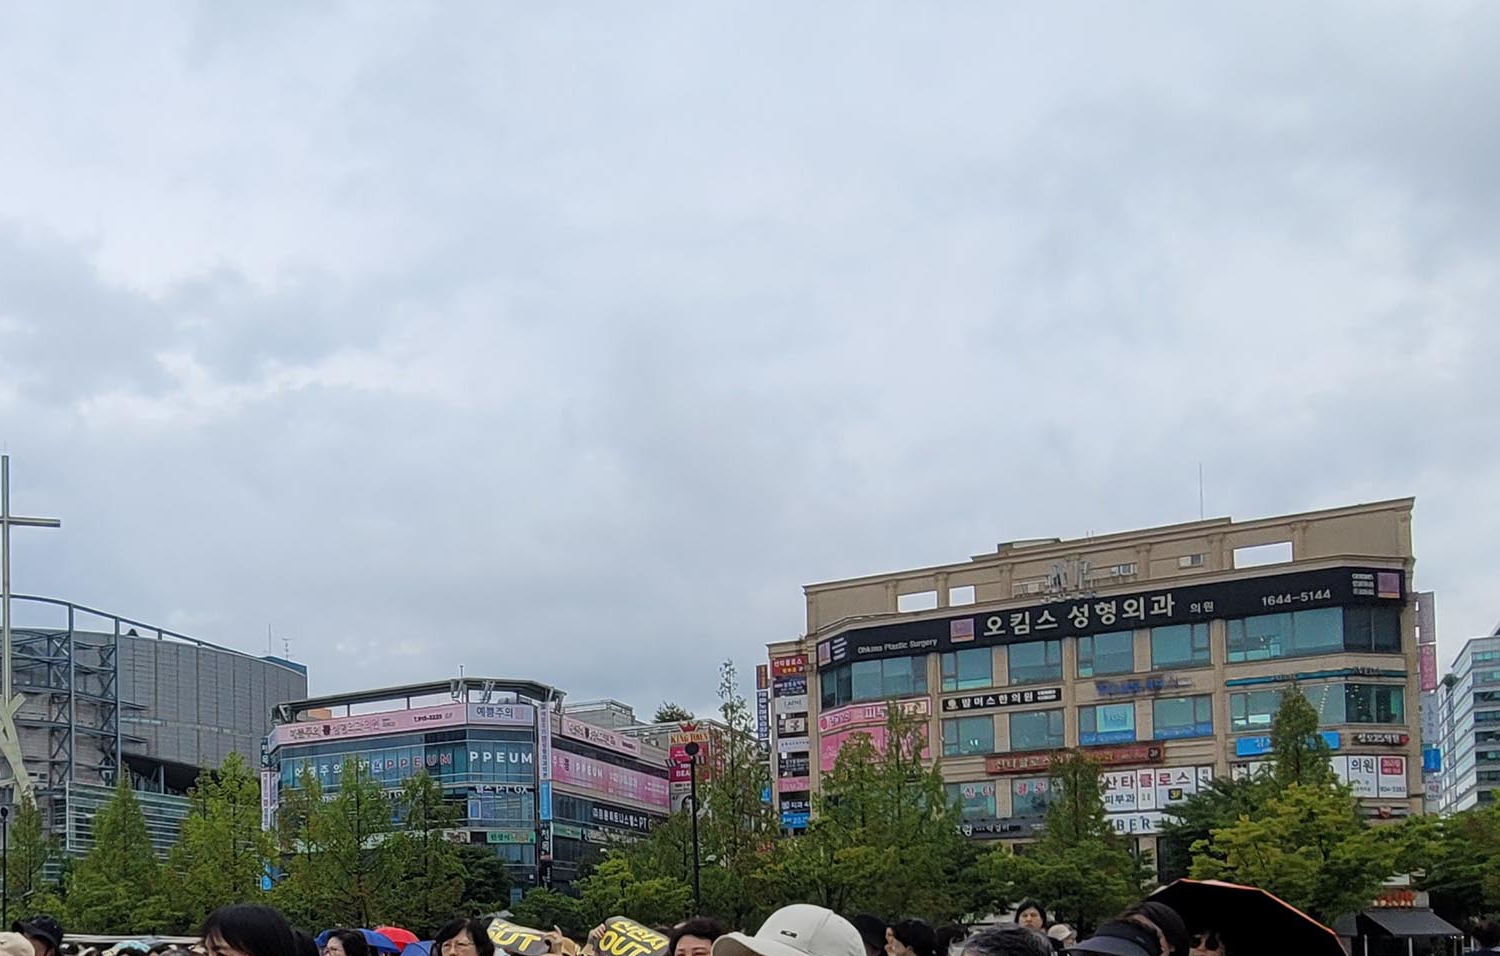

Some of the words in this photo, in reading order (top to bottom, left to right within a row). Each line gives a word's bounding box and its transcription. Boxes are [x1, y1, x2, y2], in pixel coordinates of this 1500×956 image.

[983, 610, 1058, 636] 오킴스
[1068, 592, 1175, 628] 성형외과
[1189, 601, 1214, 614] 의원
[1262, 589, 1331, 607] 1644-5144
[884, 641, 908, 651] Plastic
[909, 638, 937, 649] Surgery
[386, 752, 452, 768] PPEUM
[469, 751, 533, 764] PPEUM
[1351, 758, 1375, 774] 의원
[1105, 772, 1192, 791] 산타클로스
